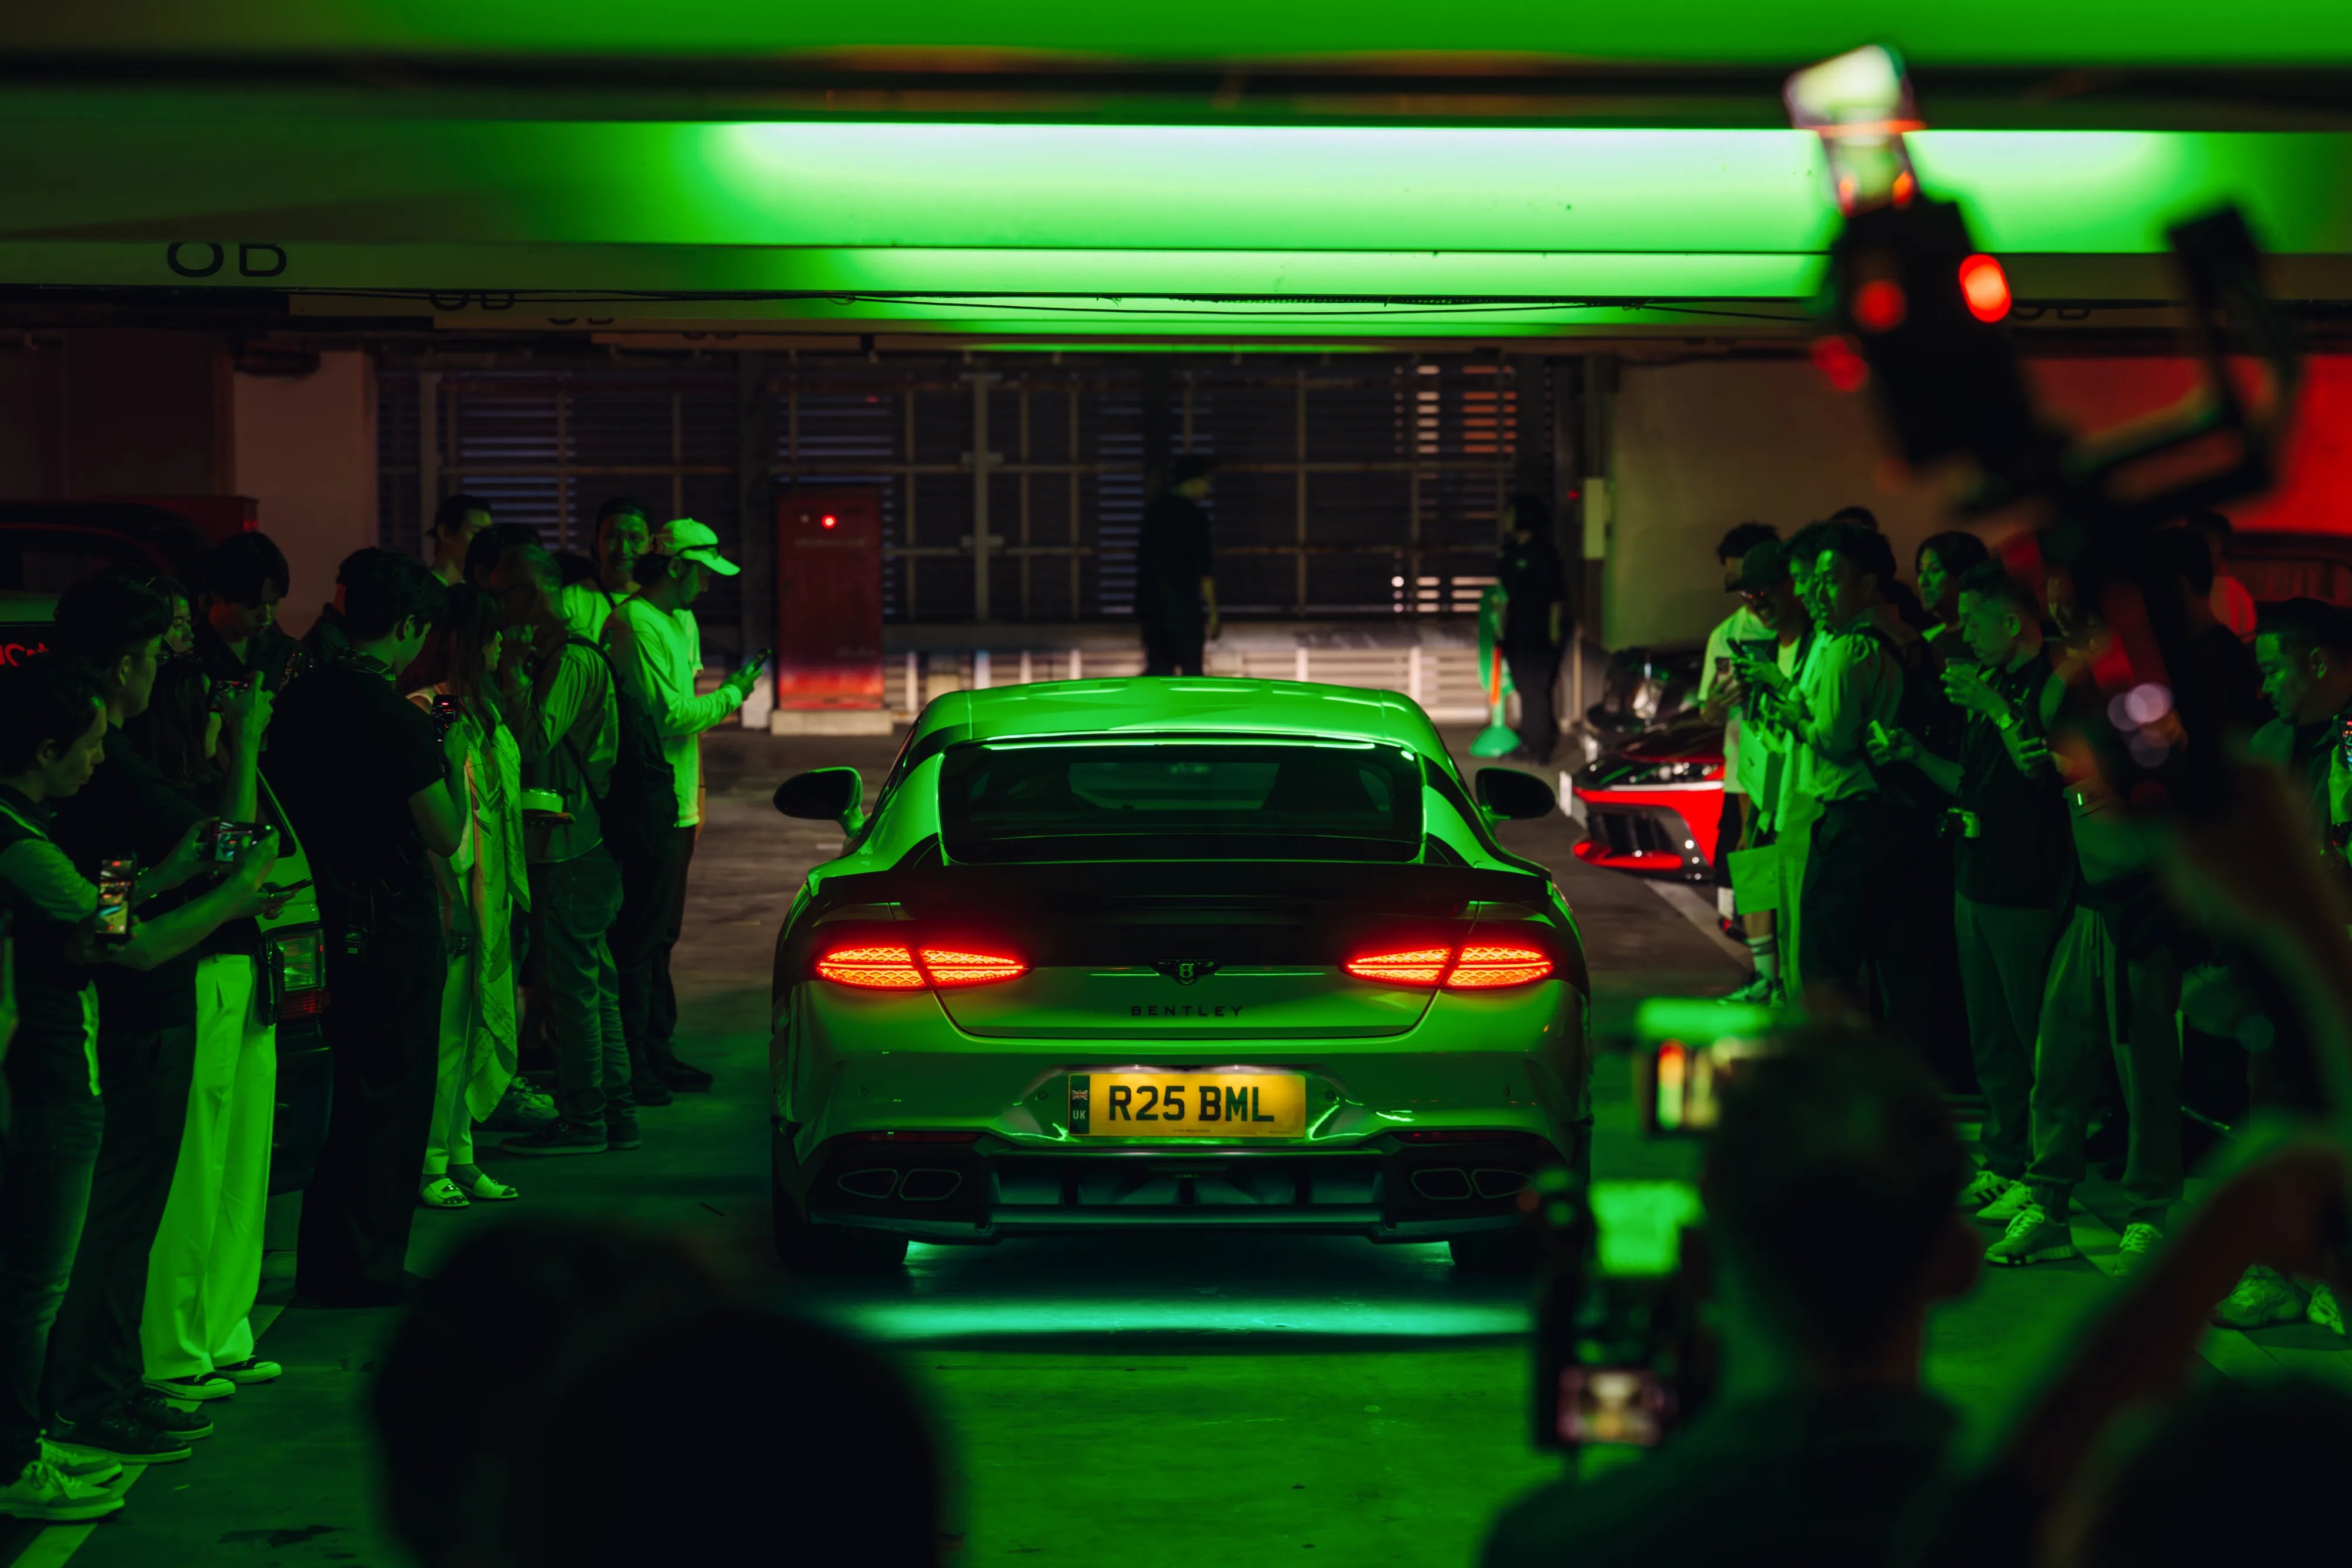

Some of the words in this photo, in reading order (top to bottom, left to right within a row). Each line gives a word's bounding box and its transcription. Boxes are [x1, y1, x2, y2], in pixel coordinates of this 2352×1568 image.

[1179, 963, 1194, 978] B
[1131, 1005, 1244, 1017] BENTLEY
[1109, 1085, 1185, 1121] R25
[1198, 1086, 1274, 1122] BML
[1073, 1110, 1086, 1120] UK
